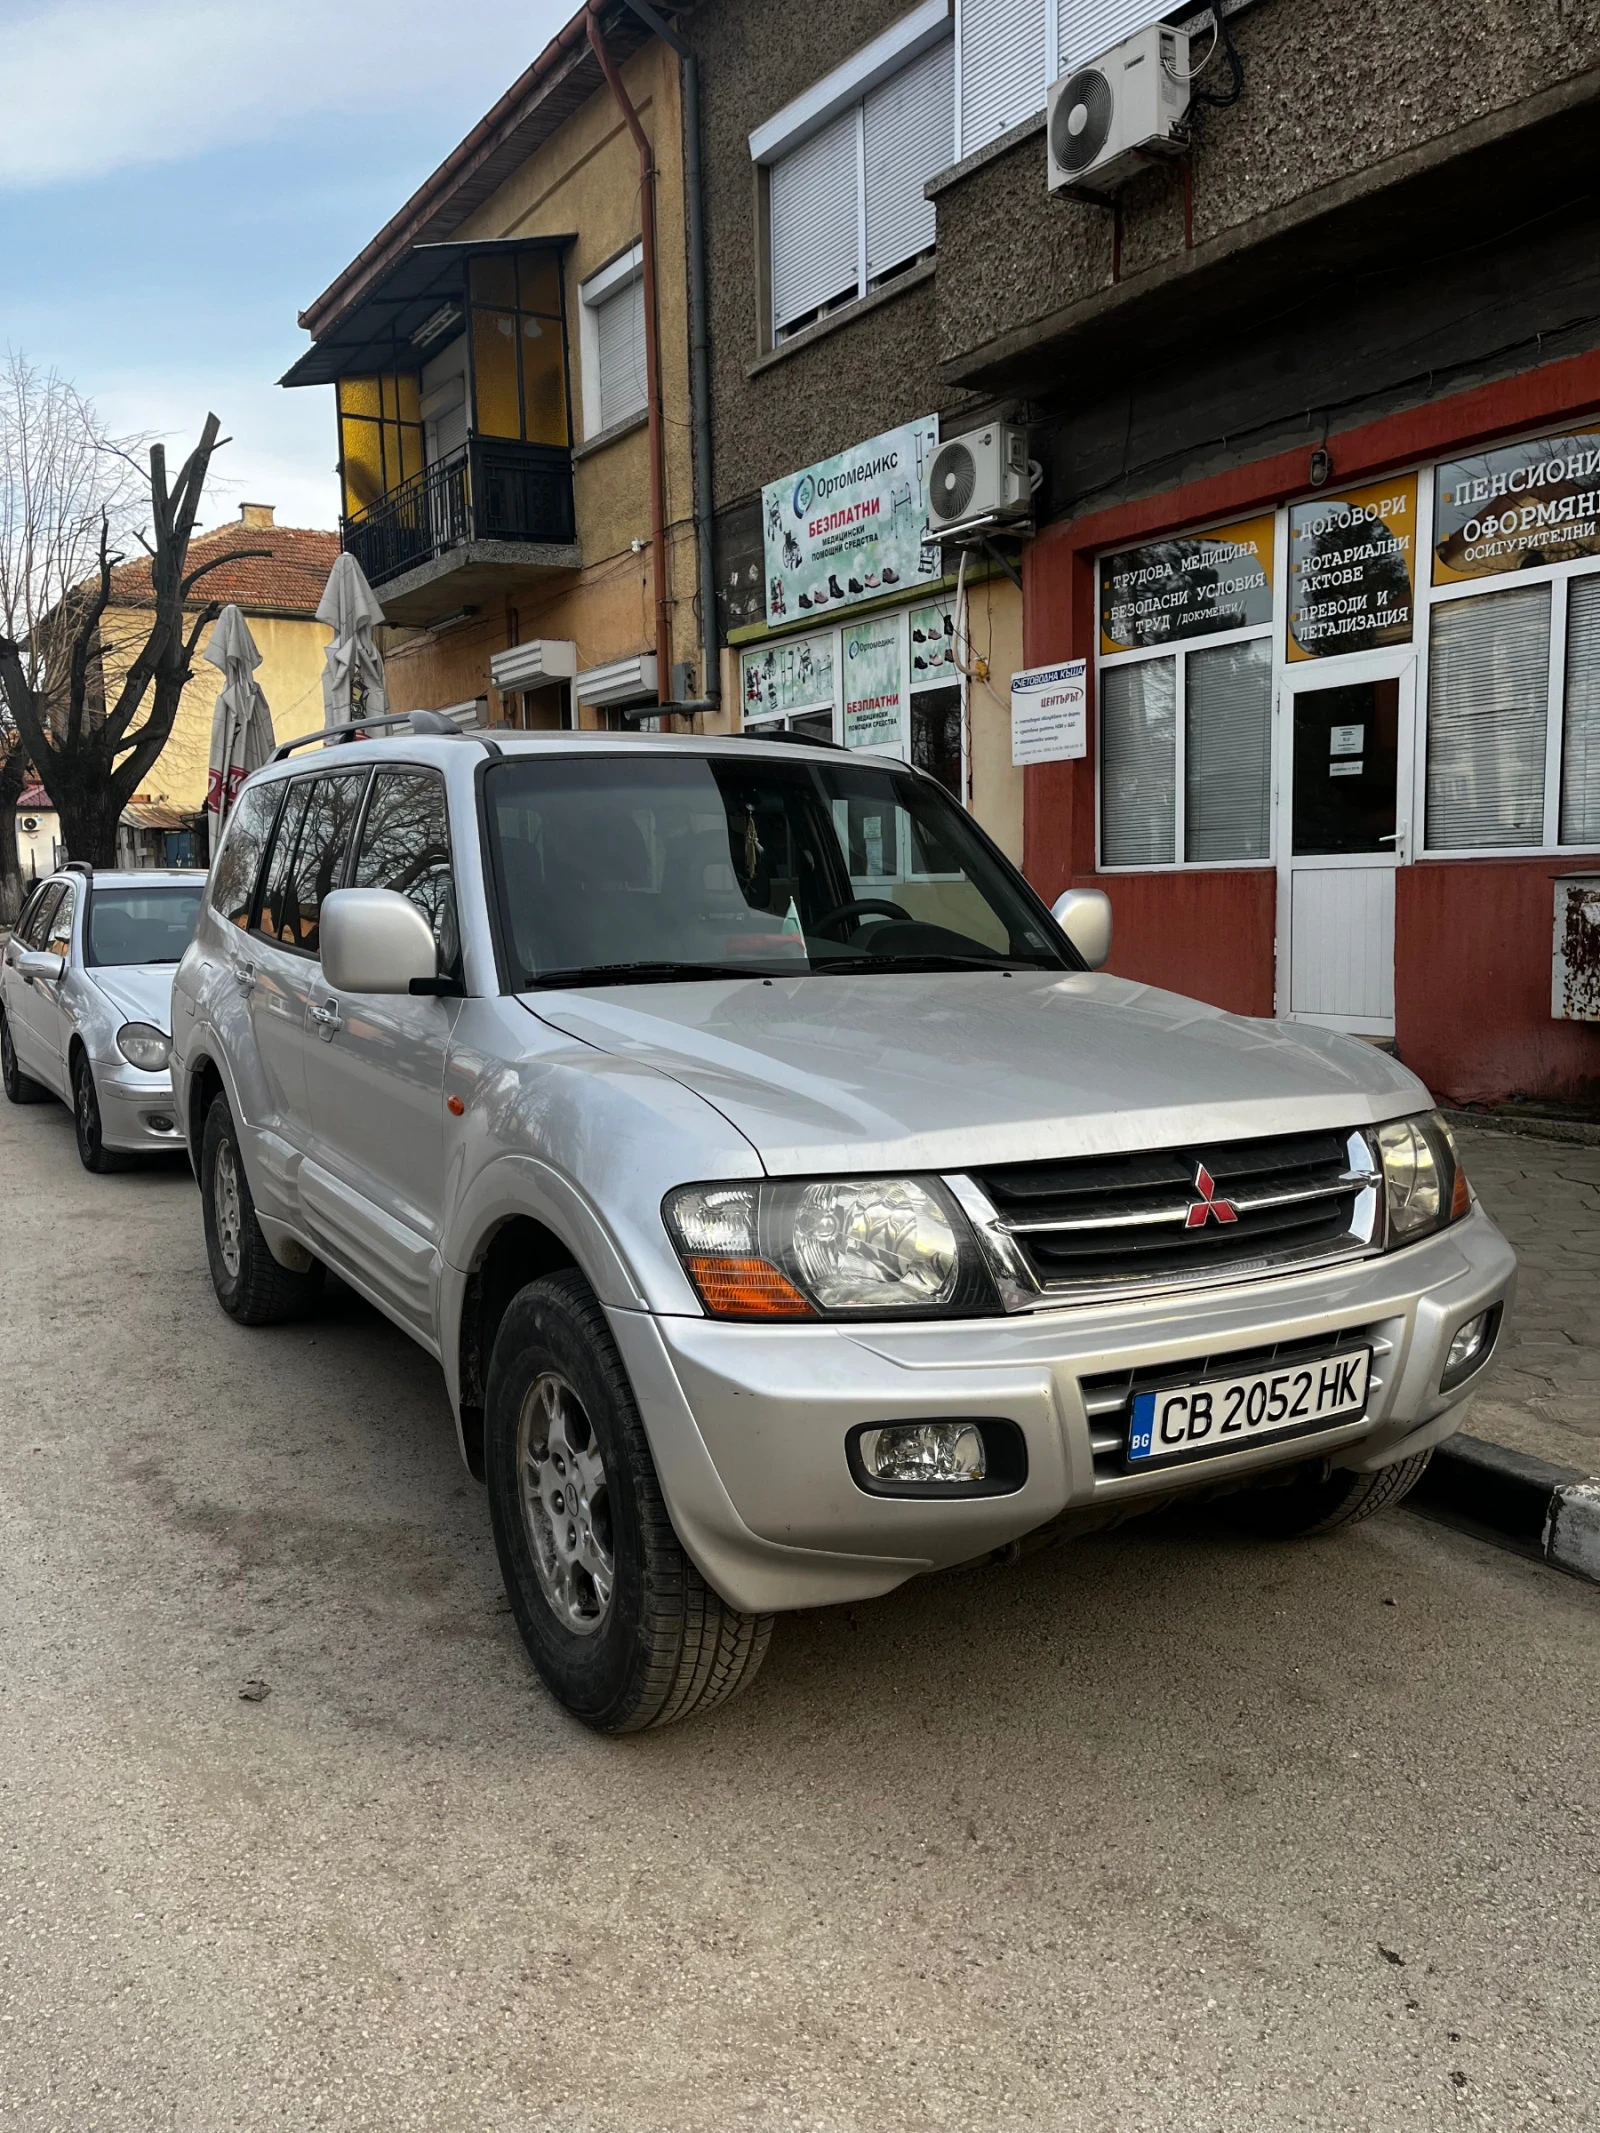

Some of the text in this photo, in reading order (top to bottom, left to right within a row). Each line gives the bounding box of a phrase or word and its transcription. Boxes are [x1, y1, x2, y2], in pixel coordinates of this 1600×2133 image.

[817, 452, 898, 499] Ортомедикс
[1454, 449, 1600, 507] ПЕНСИОНИ
[808, 497, 880, 538] БЕЗПЛАТНИ
[1300, 494, 1407, 541] ДОГОВОРИ
[1463, 489, 1600, 542] ОФОРМЯН
[812, 532, 879, 562] ПОМОЩНИ СРЕДСТВА
[822, 524, 865, 547] МЕДИЦИНСКИ
[1301, 535, 1410, 574] НОТАРИАЛНИ
[1464, 521, 1596, 561] ОСИГУРИТЕЛНИ
[1113, 541, 1259, 590] ТРУДОВА МЕДИЦИНА
[1300, 566, 1364, 594] АКТОВЕ
[1110, 572, 1265, 621] БЕЗОПАСНИ УСЛОВИЯ
[1299, 590, 1389, 622] ПРЕВОДИ И
[1110, 600, 1244, 640] НА ТРУД /ДОКУМЕНТИ/
[1298, 606, 1409, 642] ЛЕГАЛИЗАЦИЯ
[1013, 671, 1059, 689] СЧЕТОВОДНА
[847, 693, 899, 714] БЕЗПЛАТНИ
[1040, 692, 1079, 708] ЦЕНТЪРЪТ
[873, 718, 897, 728] СРЕДСТВА
[1160, 1357, 1362, 1445] CB 2052 HK
[1131, 1434, 1150, 1450] BG
